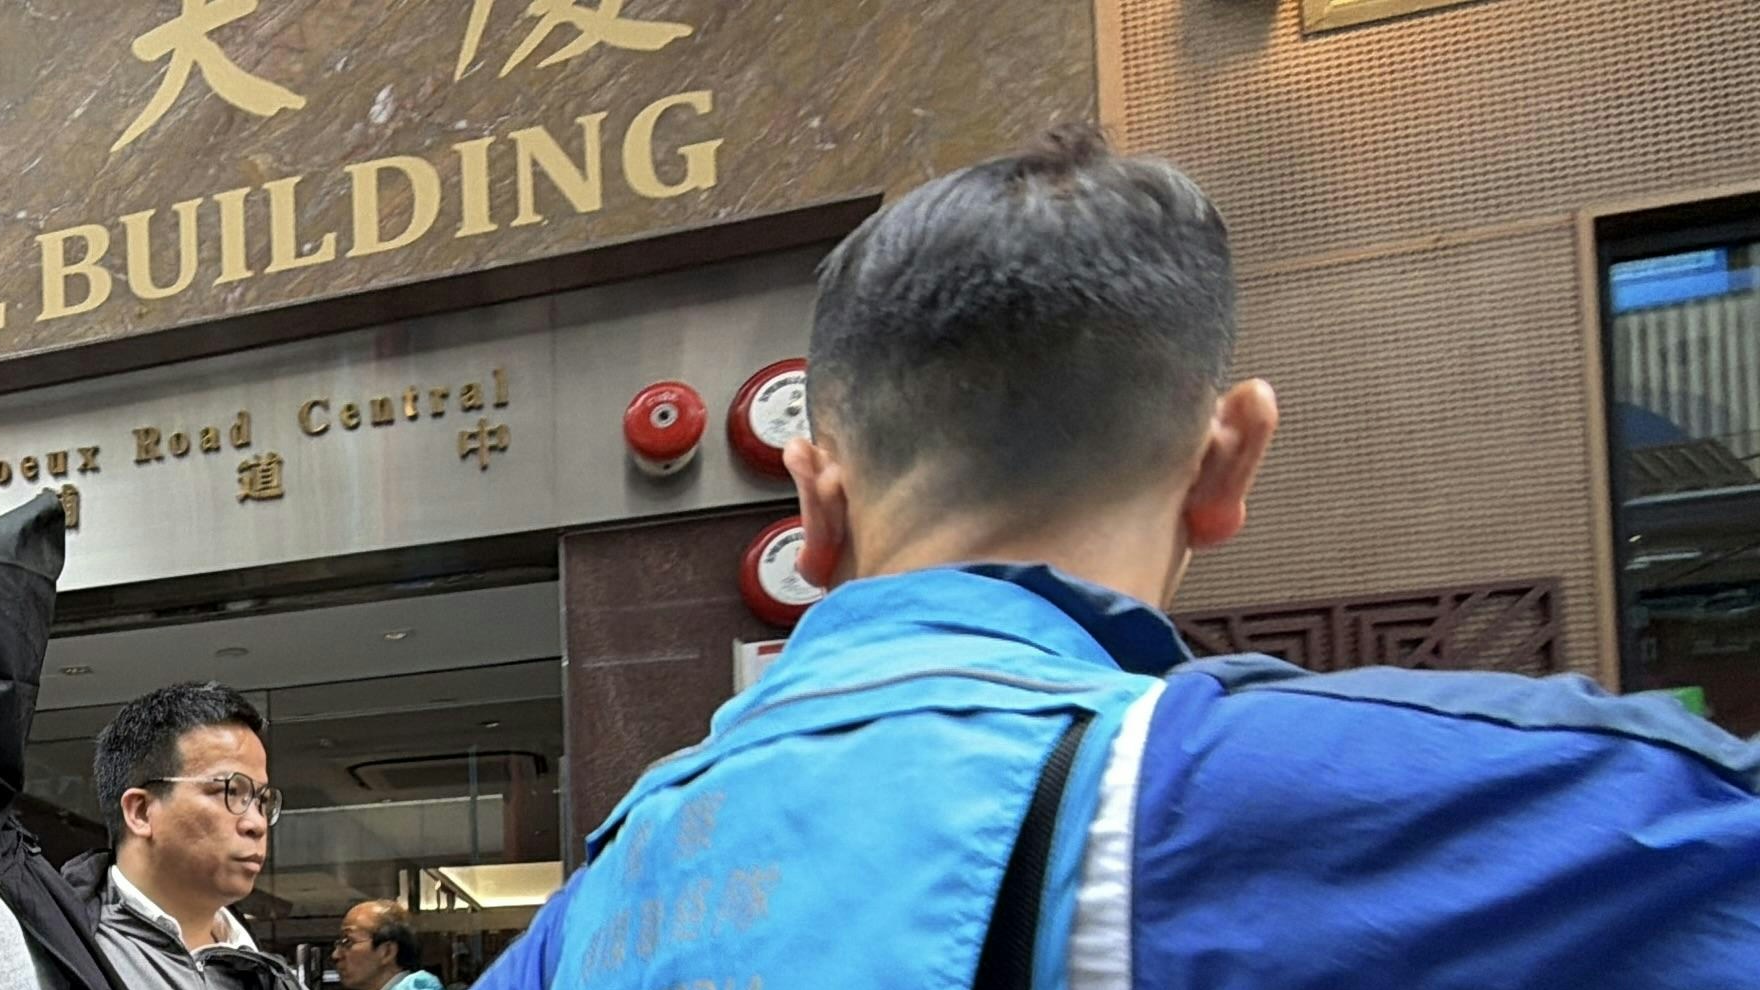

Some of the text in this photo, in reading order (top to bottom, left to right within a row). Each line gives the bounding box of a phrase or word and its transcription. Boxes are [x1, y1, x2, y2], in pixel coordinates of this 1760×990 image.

[34, 90, 724, 322] BUILDING
[132, 409, 252, 466] Road
[297, 367, 511, 437] Central
